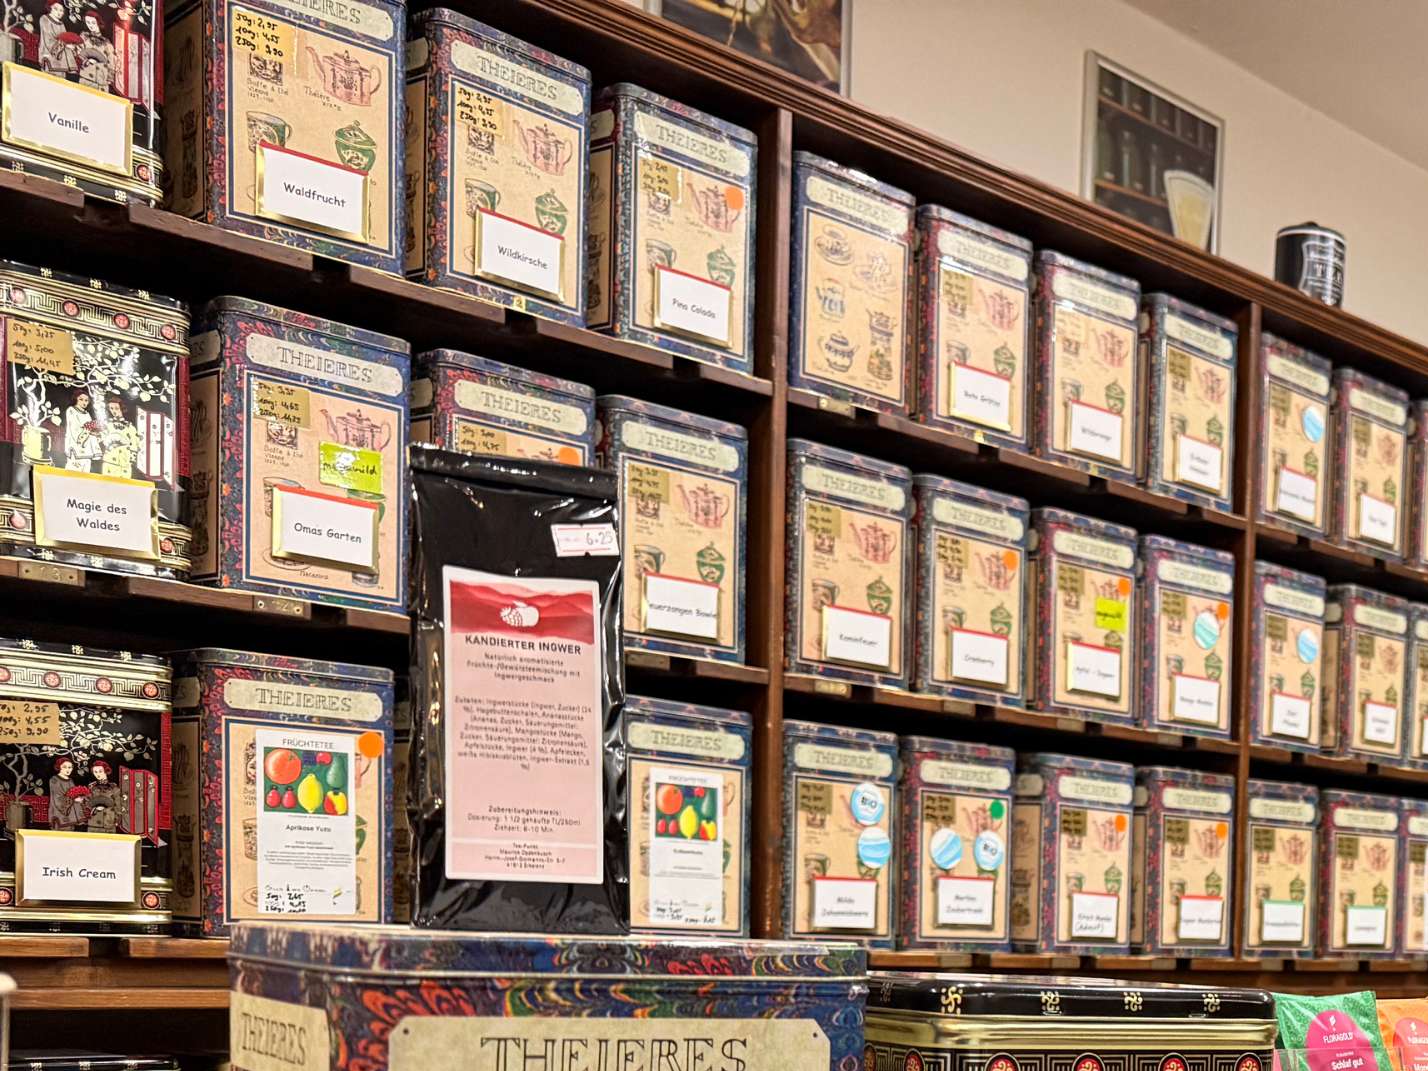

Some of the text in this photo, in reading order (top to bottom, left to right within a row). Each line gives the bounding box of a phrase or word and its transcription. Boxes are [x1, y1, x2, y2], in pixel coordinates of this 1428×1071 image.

[477, 55, 558, 101] THEIERES
[48, 111, 90, 135] Vanille
[283, 181, 347, 209] Waldfrucht
[496, 245, 549, 271] Wildkirsche
[277, 346, 373, 384] THEIERES
[482, 391, 562, 424] THEIERES
[67, 498, 127, 515] Magie des
[76, 517, 120, 532] Waldes
[294, 522, 362, 544] Omas Garten
[465, 635, 582, 655] KANDIERTER INGWER
[256, 688, 352, 712] THEIERES
[282, 737, 335, 750] FRÜCHTETEE
[651, 730, 722, 751] THEIERES
[42, 866, 116, 880] Irish Cream
[240, 1012, 308, 1067] THEIERES
[1322, 1031, 1354, 1044] FLORAGOLD
